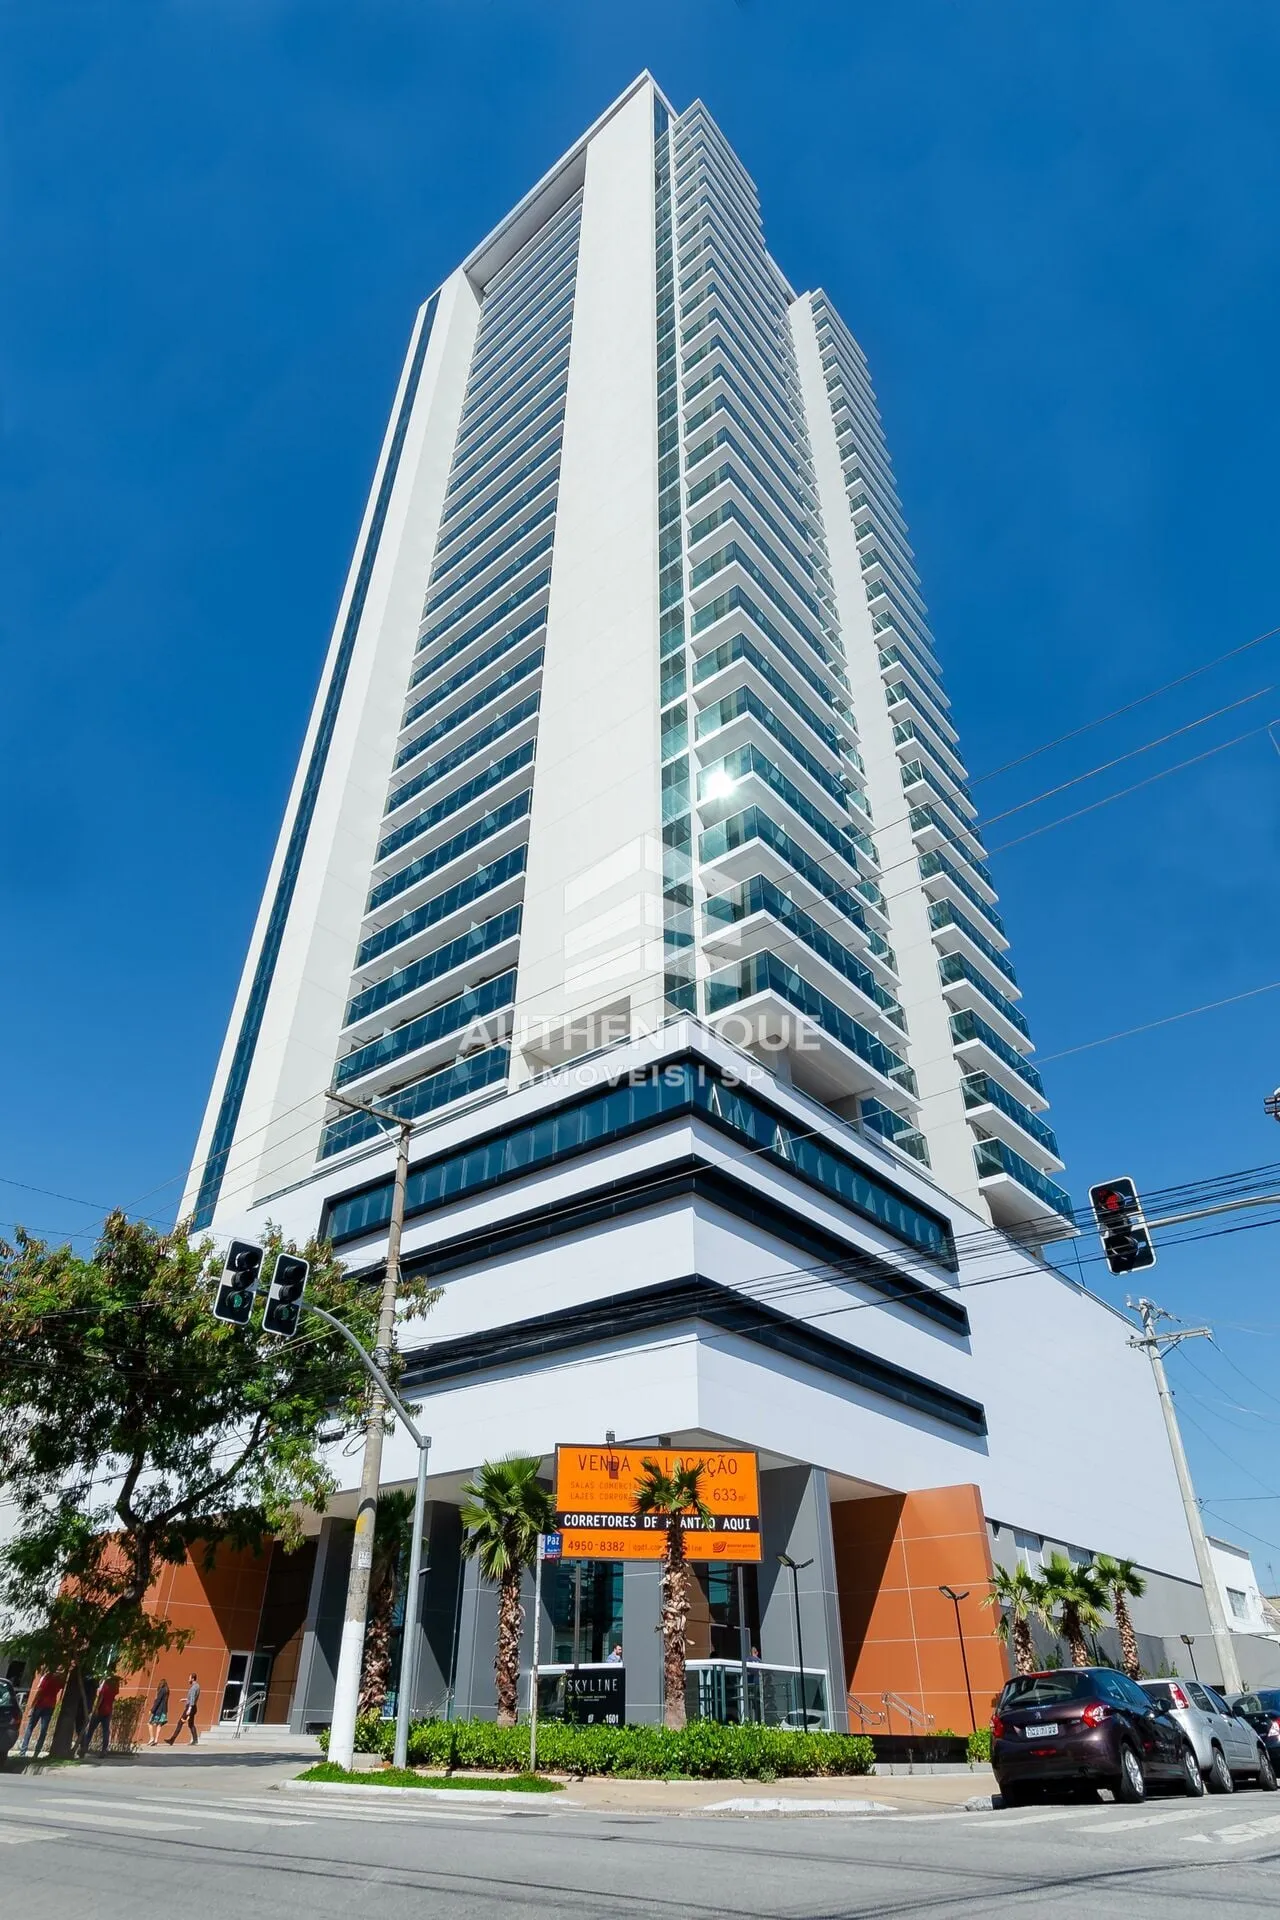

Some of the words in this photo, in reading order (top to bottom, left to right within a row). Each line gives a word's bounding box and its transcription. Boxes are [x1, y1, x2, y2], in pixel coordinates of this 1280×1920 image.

[578, 1454, 631, 1472] VENDA
[713, 1488, 737, 1502] 633
[564, 1514, 636, 1528] CORRETORES
[723, 1518, 751, 1530] AQUI
[547, 1535, 560, 1545] Paz
[568, 1541, 625, 1551] 4950-8382
[567, 1678, 618, 1692] SKYLINE
[605, 1714, 619, 1724] 1601
